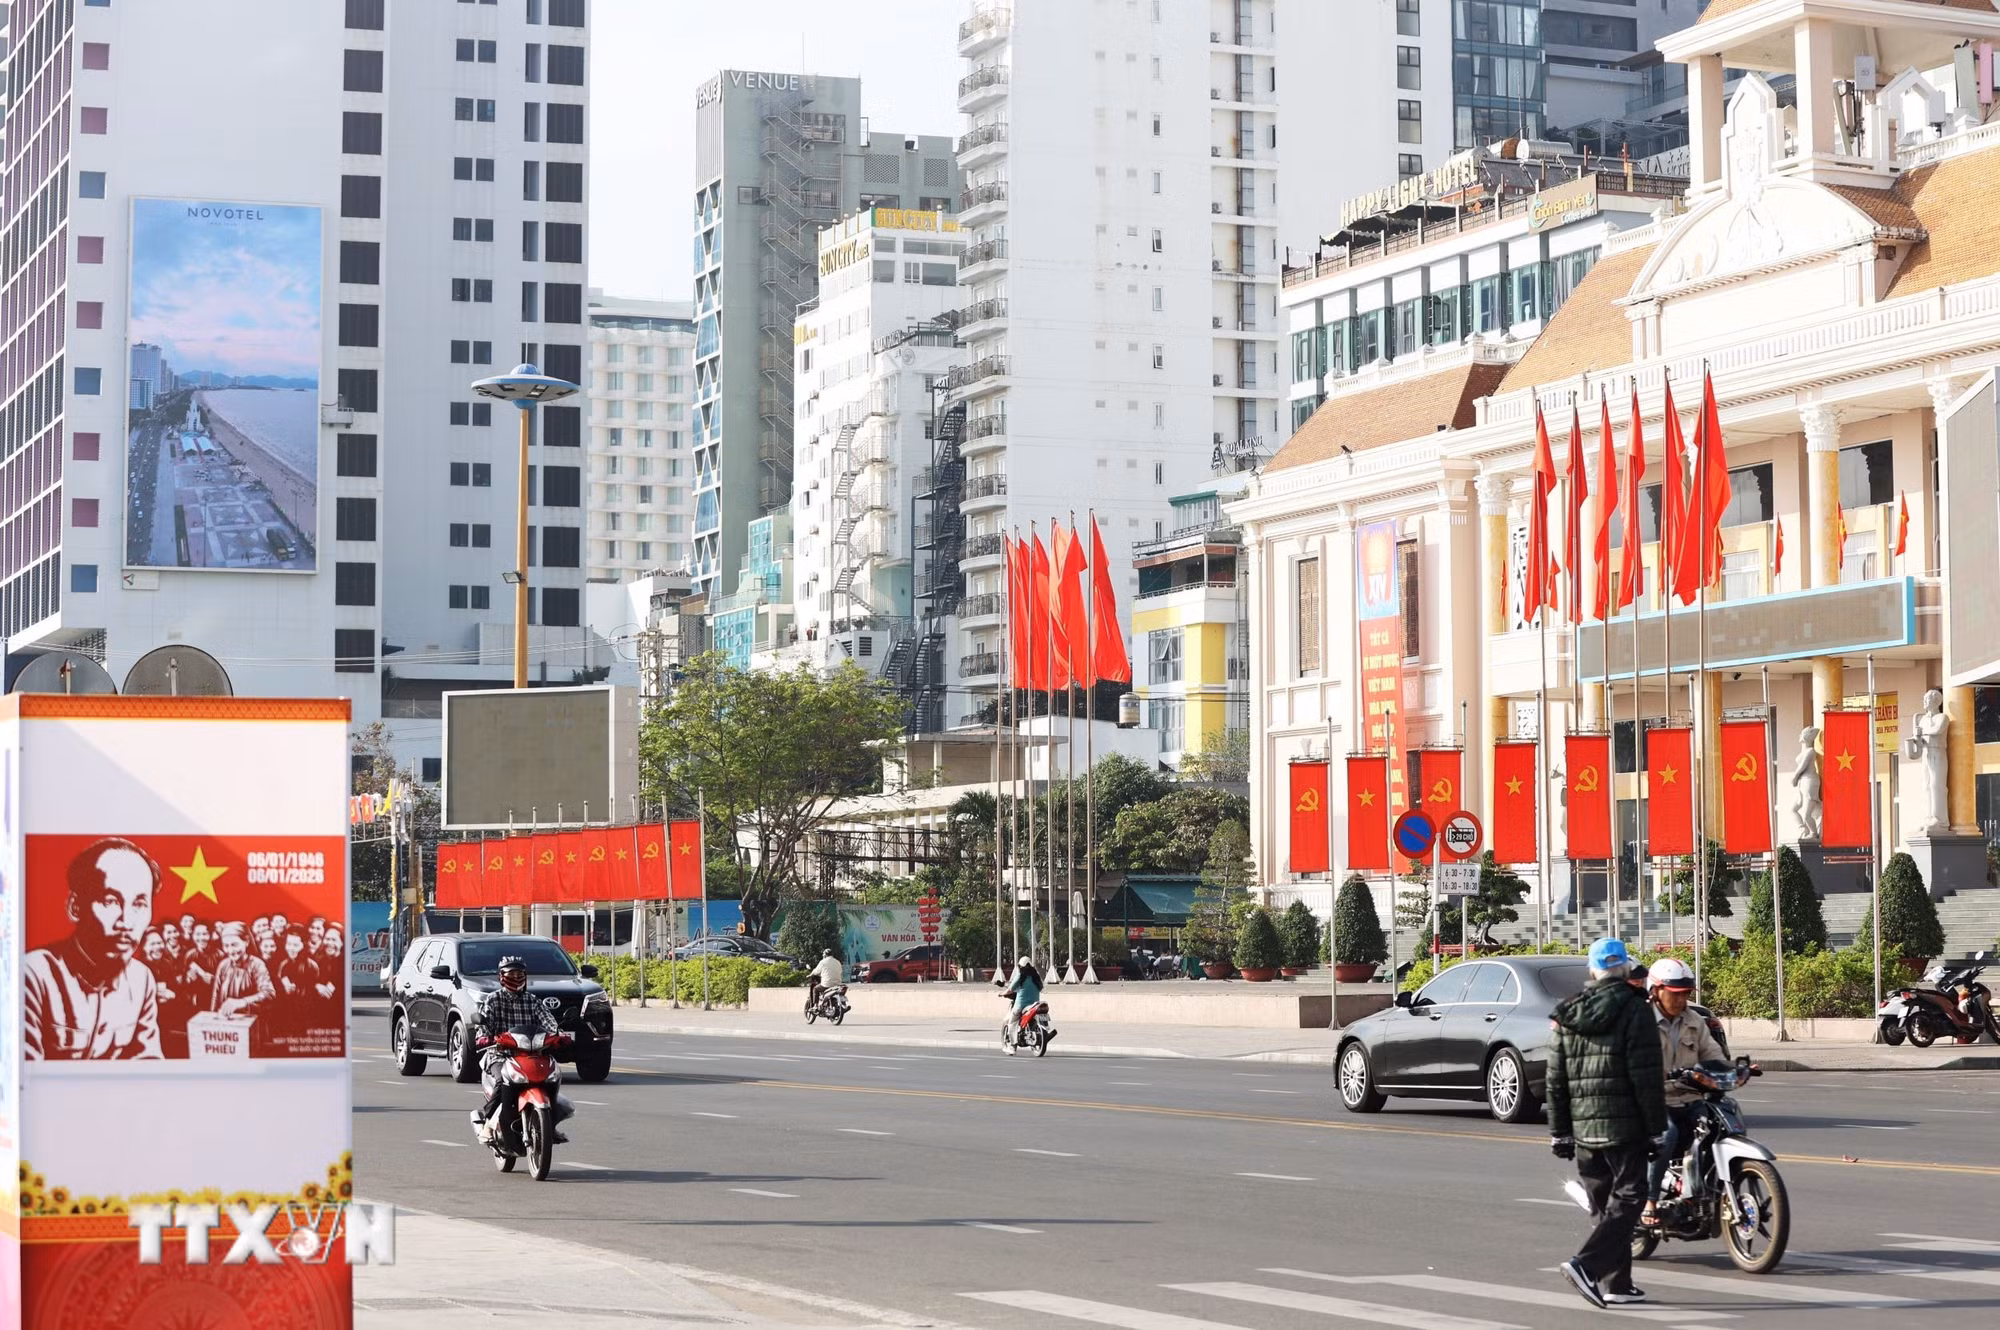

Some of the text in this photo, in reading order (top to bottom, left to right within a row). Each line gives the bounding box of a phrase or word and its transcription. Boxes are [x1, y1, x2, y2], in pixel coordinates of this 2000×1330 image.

[729, 70, 799, 91] VENUE
[1340, 155, 1478, 227] HAPPY LIGHT HOTEL
[187, 207, 264, 221] NOVOTEL
[839, 239, 858, 270] CITY
[247, 868, 325, 885] 06/01/2026
[1445, 868, 1458, 877] 6:30
[1463, 868, 1476, 877] 7:30
[1441, 881, 1458, 890] 16:30
[1463, 881, 1478, 891] 18:30
